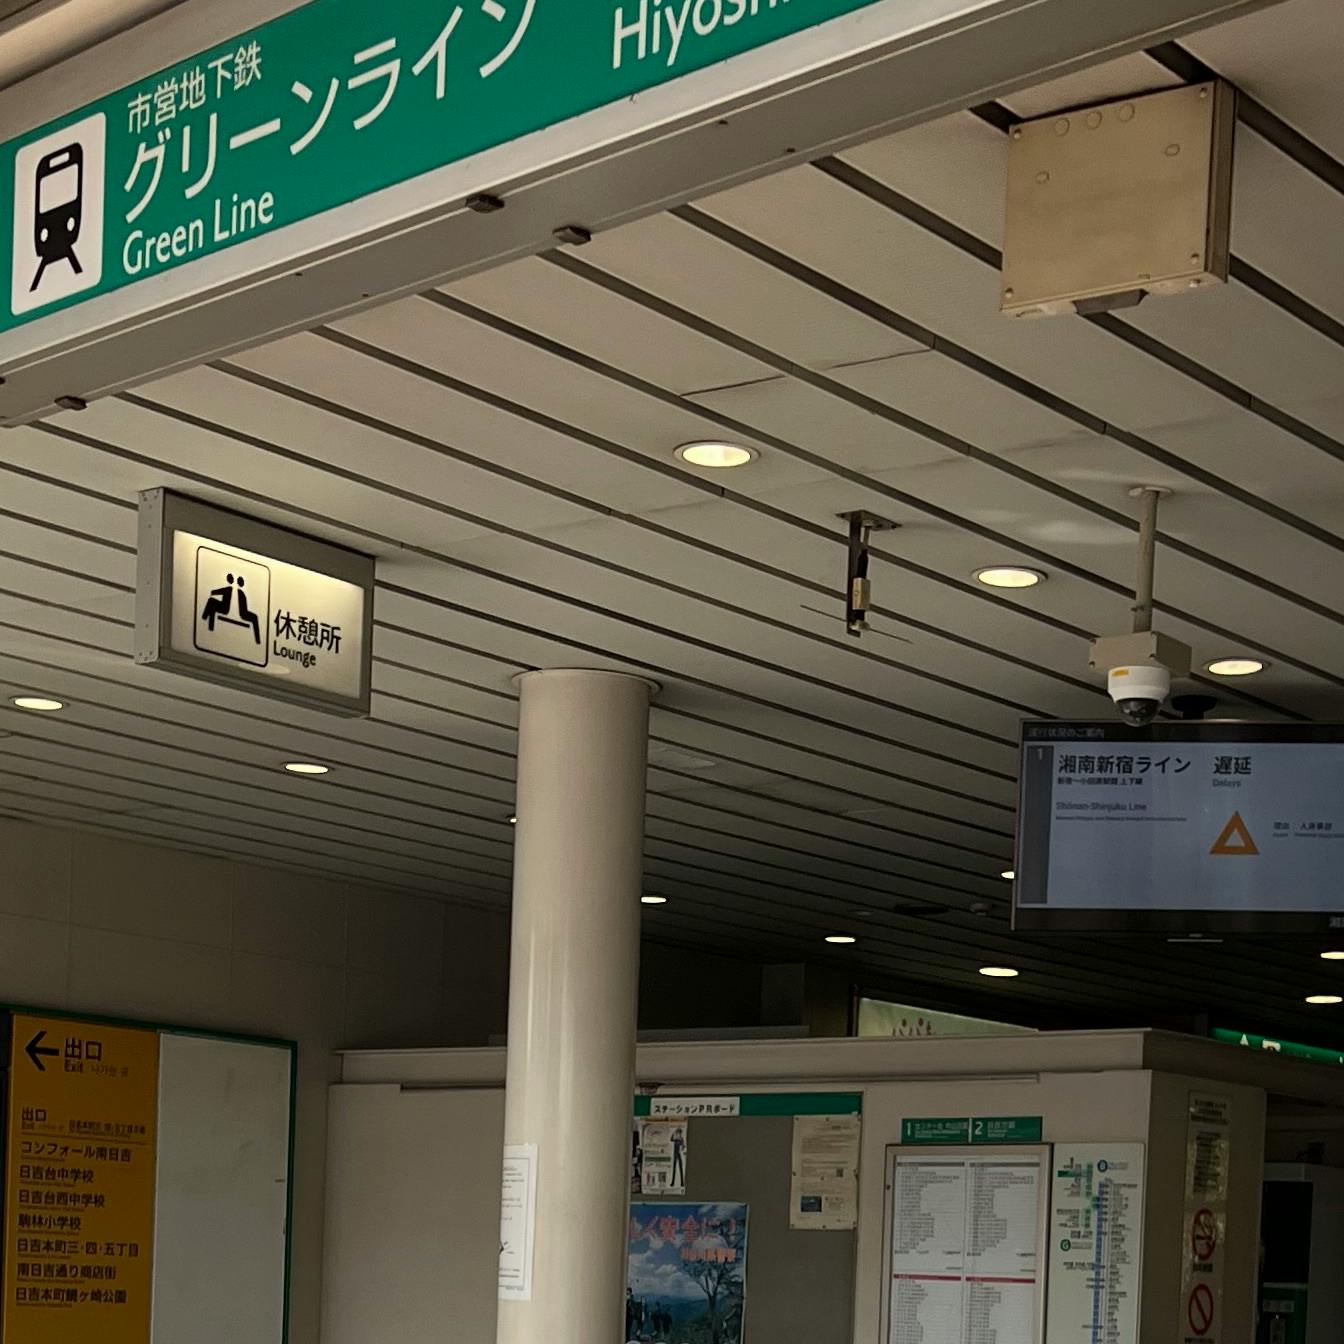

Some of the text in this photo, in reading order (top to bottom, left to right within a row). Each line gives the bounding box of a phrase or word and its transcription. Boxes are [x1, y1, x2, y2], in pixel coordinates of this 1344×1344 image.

[613, 0, 790, 69] Hiyos
[127, 40, 262, 134] 市営地下鉄
[123, 0, 538, 224] グリーンライン
[122, 191, 274, 275] Green Line
[273, 609, 342, 654] 休憩所
[273, 640, 317, 668] Lounge
[1058, 754, 1252, 775] 湘南新宿ライン 遅延
[64, 1037, 103, 1061] 出口
[64, 1060, 83, 1073] Exit
[22, 1107, 47, 1121] 出口
[905, 1122, 911, 1136] 1
[974, 1121, 983, 1136] 2
[21, 1140, 132, 1162] コンフォール南日吉
[19, 1164, 94, 1184] 日吉台中学校
[18, 1188, 105, 1208] 日吉台西中学校
